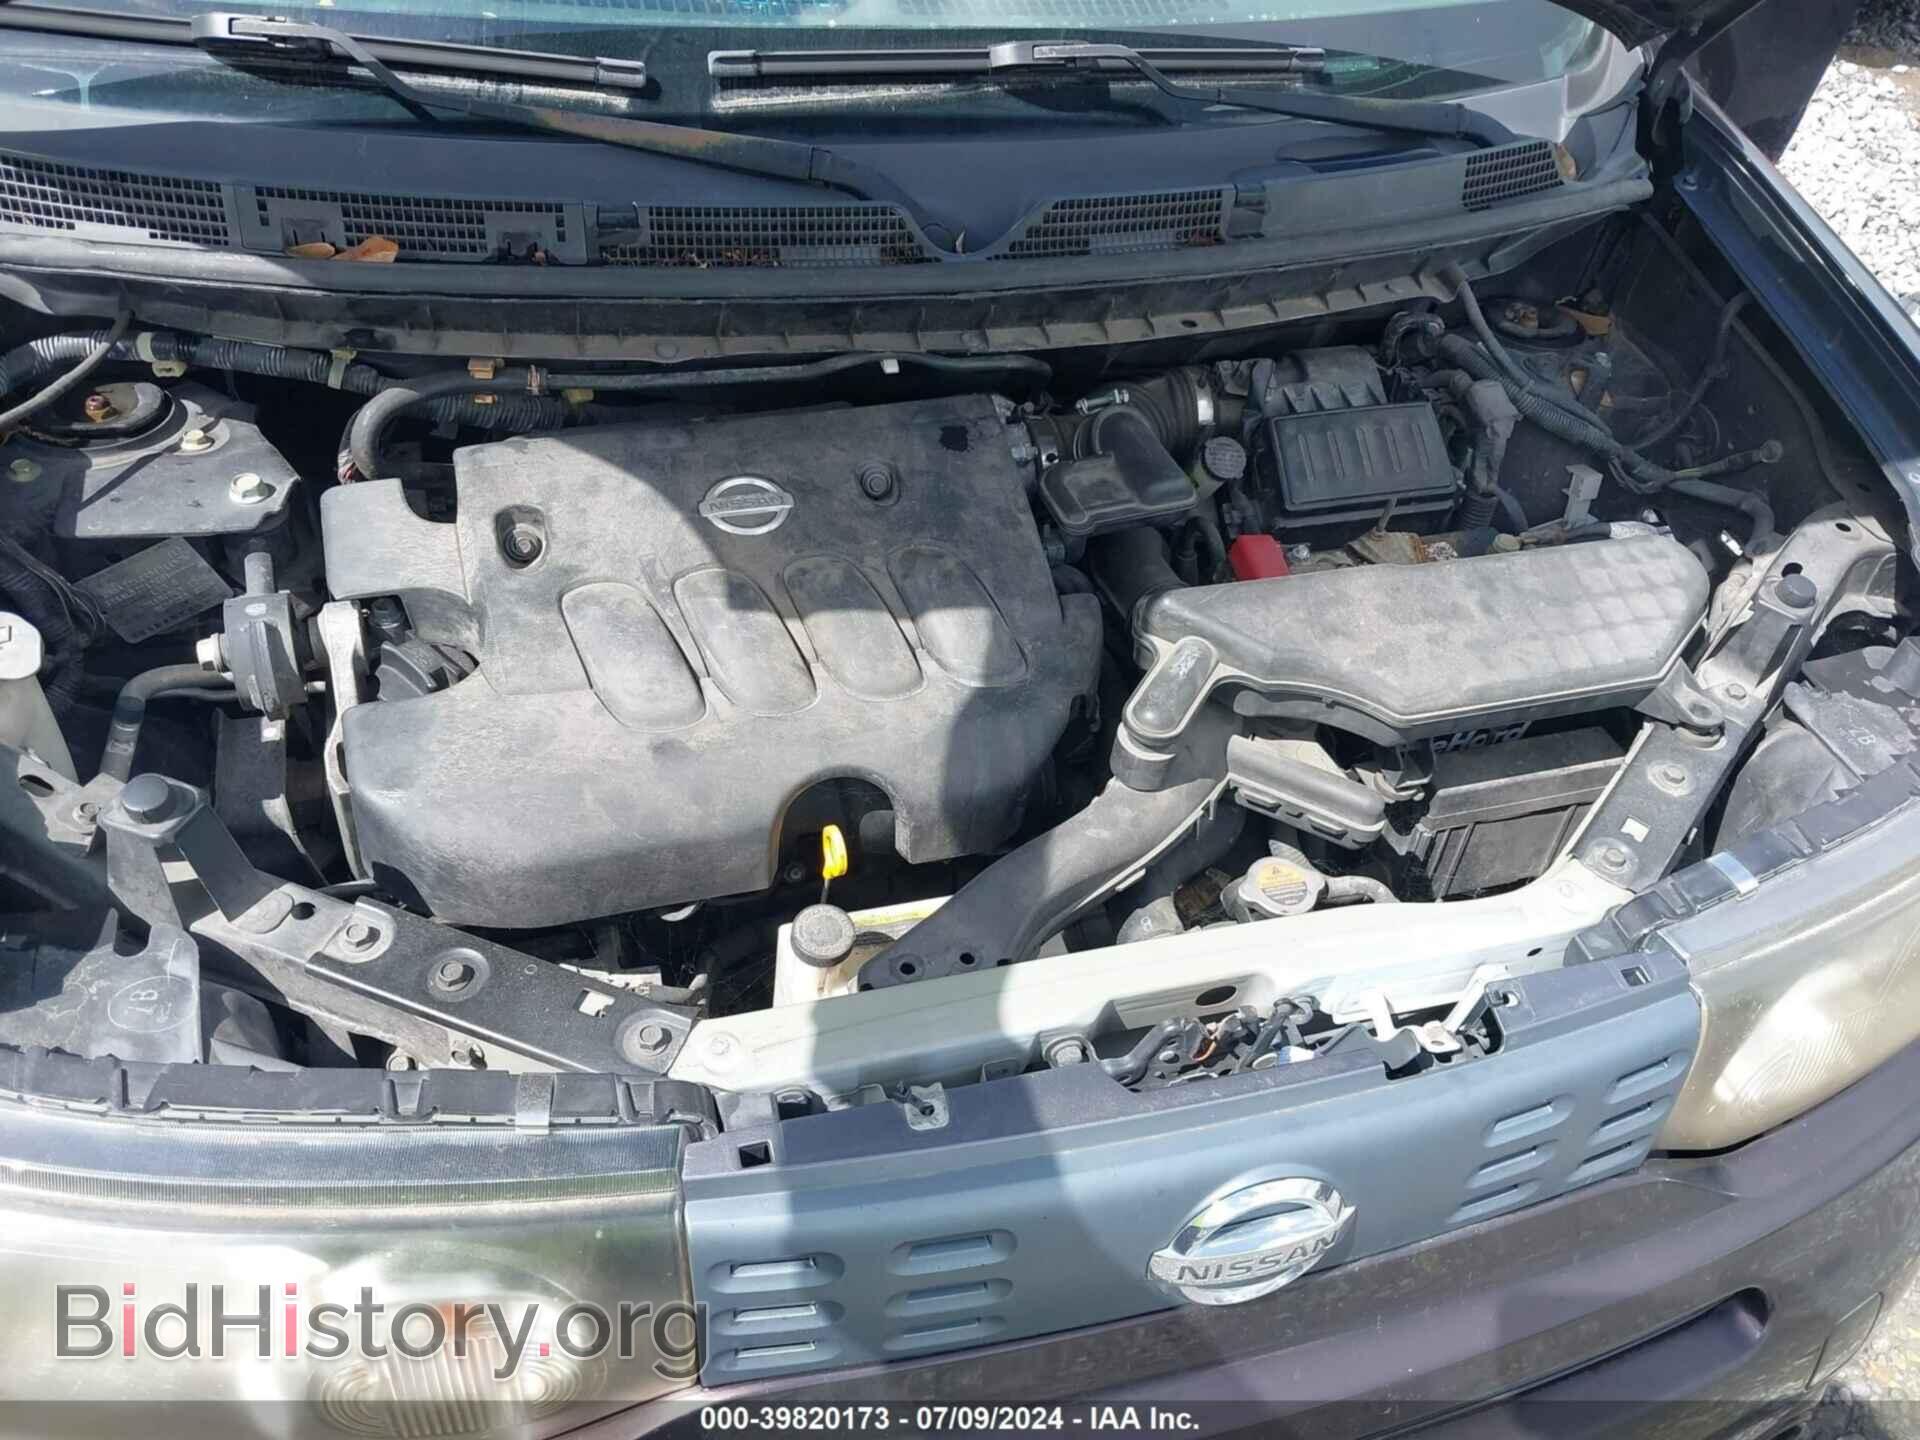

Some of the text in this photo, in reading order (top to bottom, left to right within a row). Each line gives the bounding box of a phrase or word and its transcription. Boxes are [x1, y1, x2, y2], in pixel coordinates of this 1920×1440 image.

[708, 492, 785, 513] NISSAN
[1431, 720, 1532, 753] eHard
[1177, 1233, 1337, 1281] NISSAN
